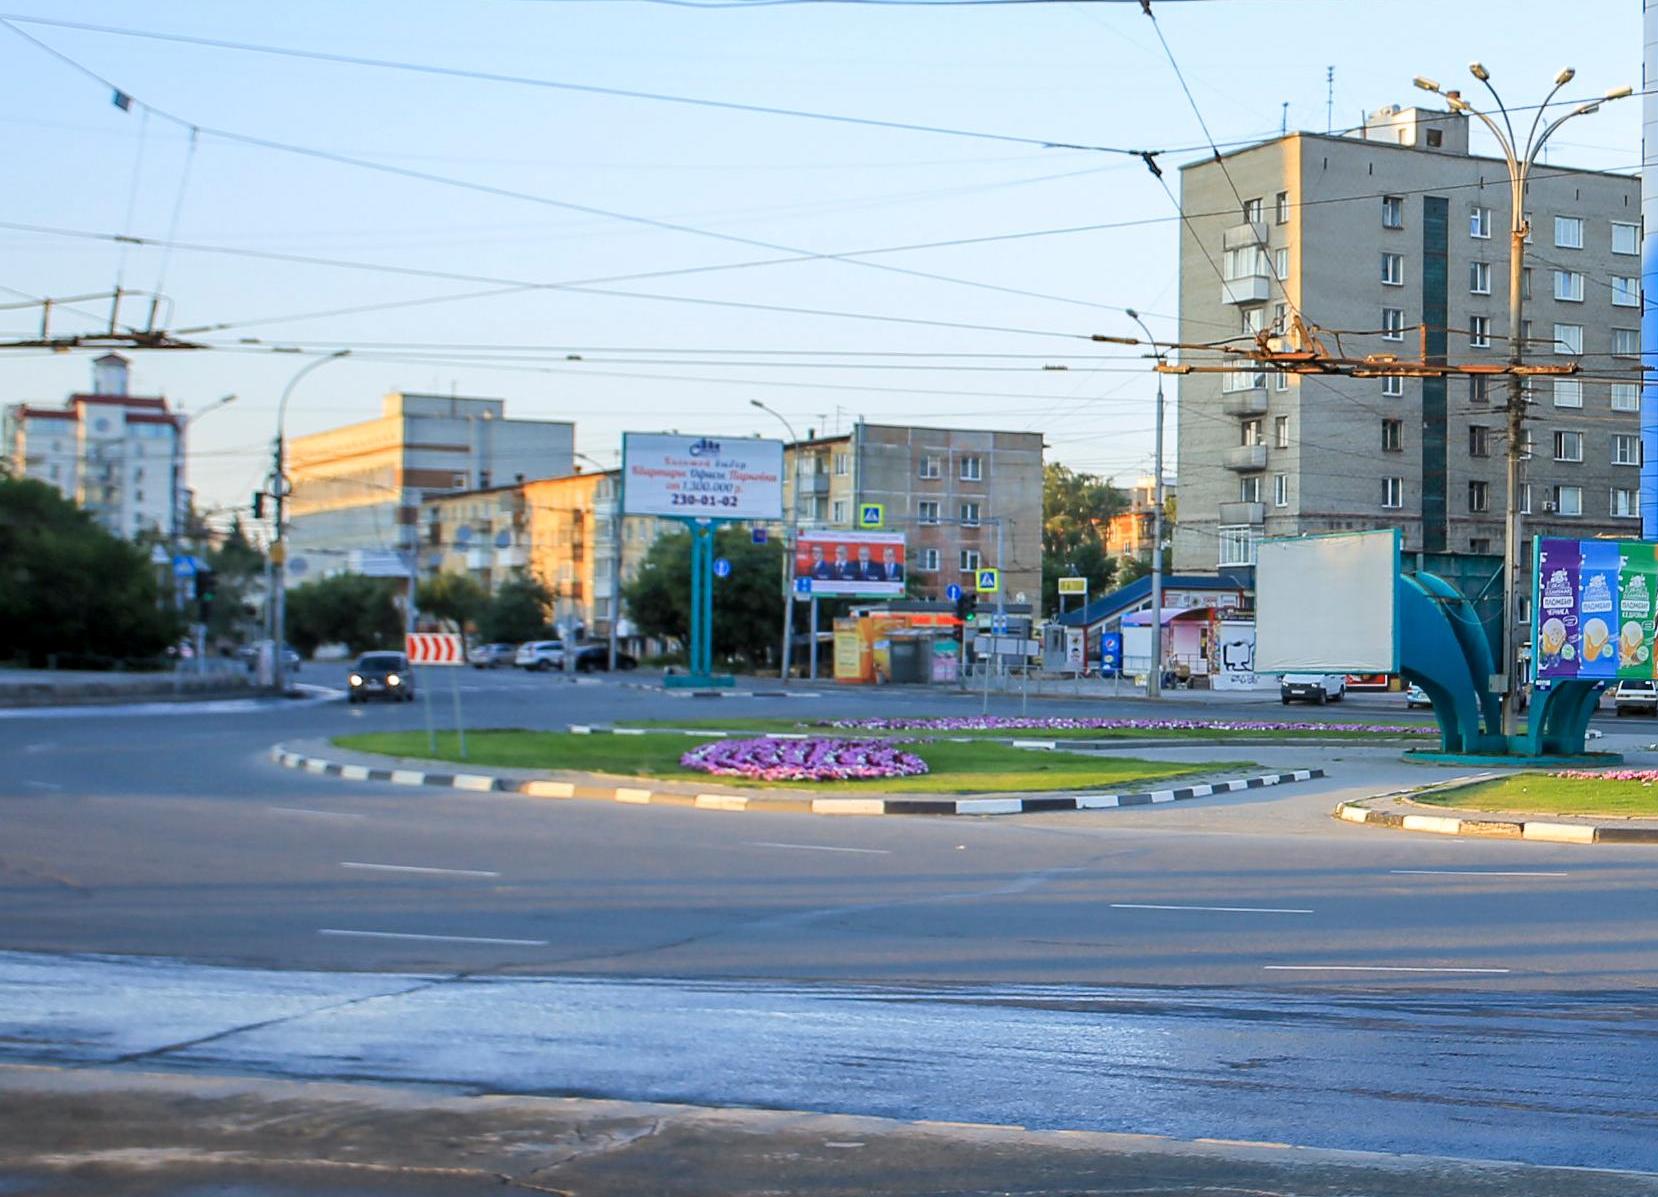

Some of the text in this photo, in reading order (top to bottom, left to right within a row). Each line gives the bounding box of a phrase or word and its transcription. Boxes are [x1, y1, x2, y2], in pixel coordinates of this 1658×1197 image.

[671, 493, 739, 507] 230-01-02
[1544, 597, 1573, 607] ПЛОМБИР
[1583, 602, 1612, 611] ПЛОМБИР
[1622, 601, 1650, 611] ПЛОМБИР
